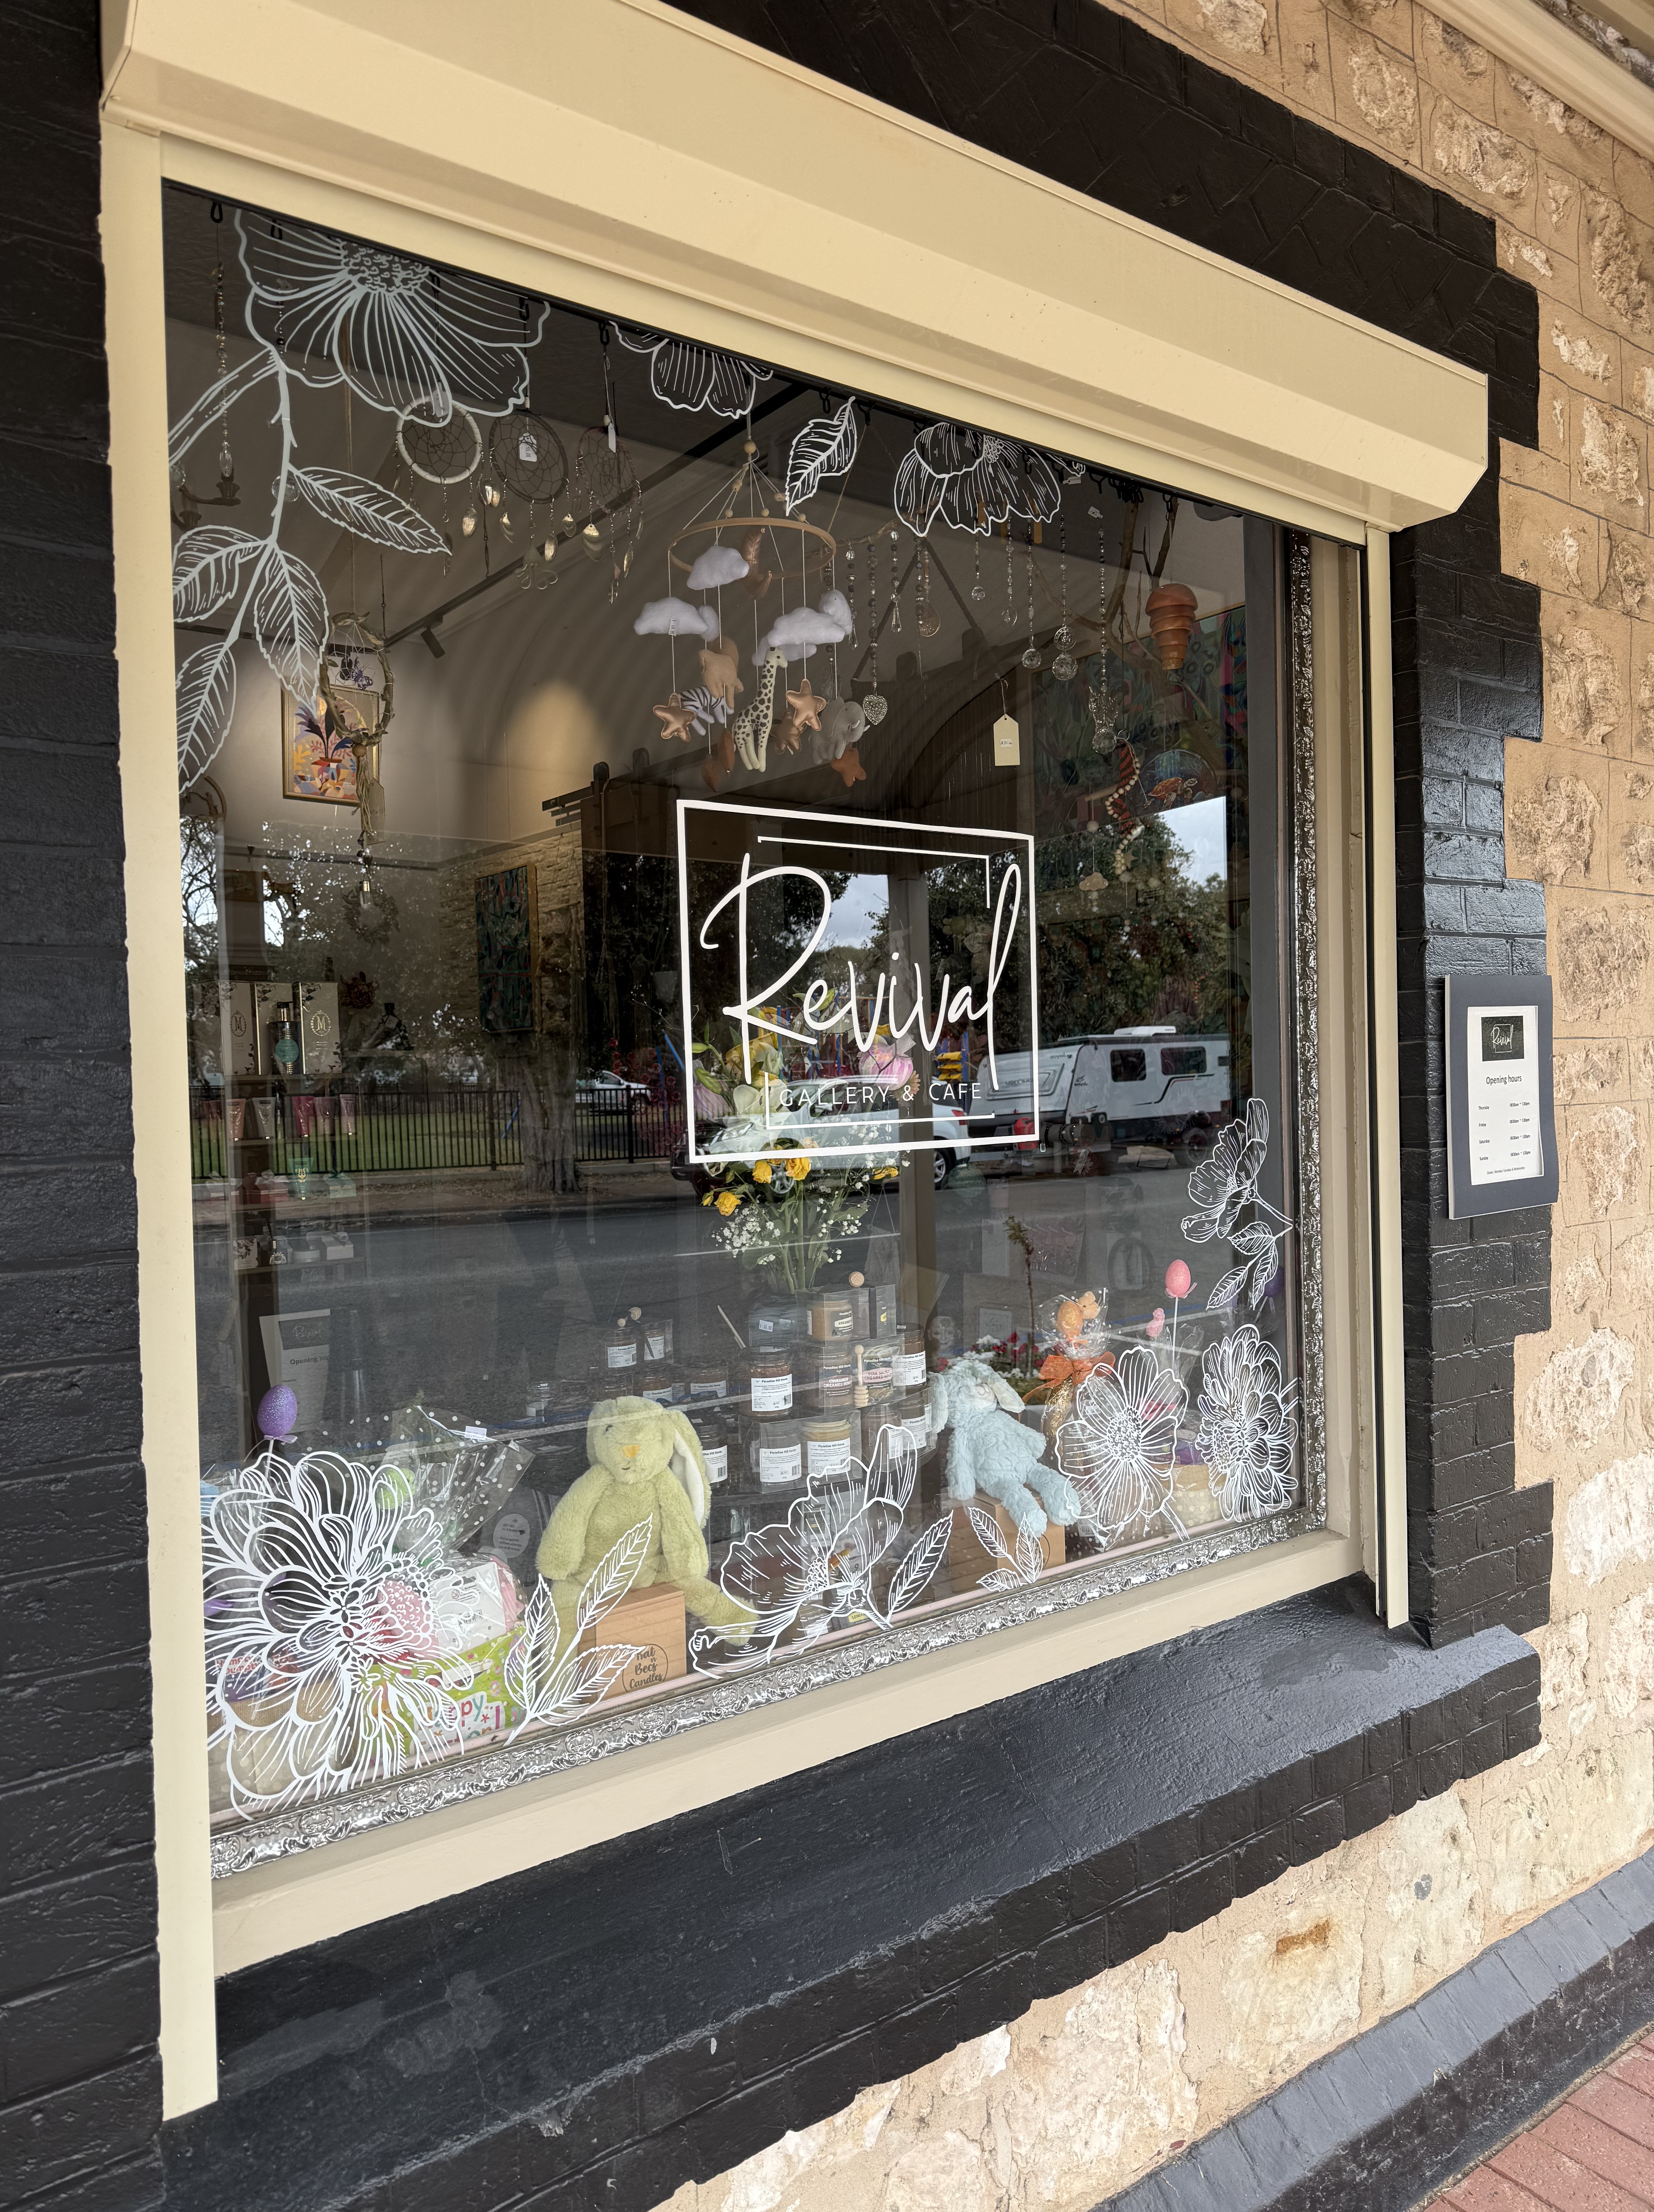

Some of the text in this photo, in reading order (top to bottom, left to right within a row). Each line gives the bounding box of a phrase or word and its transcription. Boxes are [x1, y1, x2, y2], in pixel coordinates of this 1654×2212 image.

[700, 853, 1021, 1091] Revival
[1491, 1024, 1513, 1049] Revival
[1486, 1075, 1507, 1085] Opening
[779, 1083, 981, 1106] GALLERY & CAFE
[290, 1357, 318, 1365] Opening
[635, 1662, 657, 1675] Becs
[629, 1672, 663, 1689] Candles
